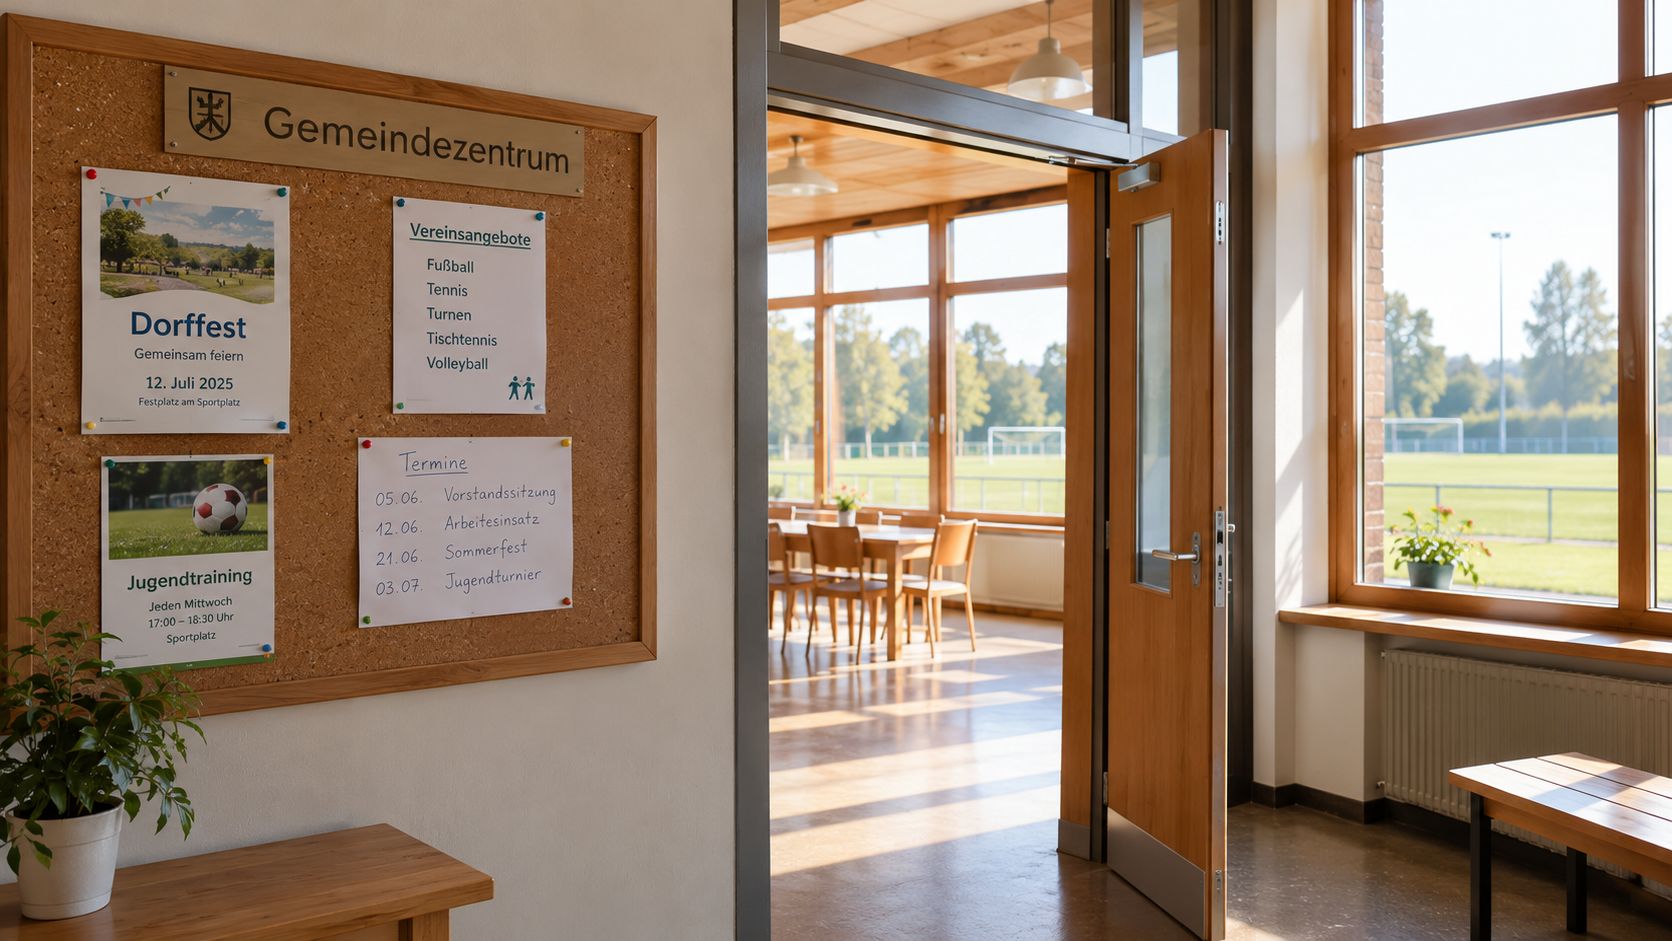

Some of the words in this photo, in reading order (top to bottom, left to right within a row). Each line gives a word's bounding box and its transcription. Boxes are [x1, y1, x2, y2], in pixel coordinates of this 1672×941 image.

[263, 105, 570, 174] Gemeindezentrum
[409, 222, 531, 247] Vereinsangebote
[427, 257, 475, 274] Fußball
[427, 282, 468, 297] Tennis
[427, 307, 473, 321] Turnen
[131, 311, 247, 339] Dorffest
[427, 331, 498, 347] Tischtennis
[134, 347, 207, 361] Gemeinsam
[210, 349, 244, 362] feiern
[427, 356, 488, 372] Volleyball
[146, 376, 167, 390] 12.
[171, 376, 195, 390] Juli
[199, 377, 234, 391] 2025
[138, 397, 180, 408] Festplatz
[181, 399, 195, 407] am
[197, 398, 241, 409] Sportplatz
[399, 451, 468, 472] Termine
[375, 490, 422, 506] 05.06.
[444, 484, 557, 505] Vorstandssitzung
[375, 520, 422, 536] 12.06.
[444, 511, 541, 531] Arbeitesinsatz
[376, 549, 422, 566] 21.06.
[445, 538, 527, 560] Sommerfest
[127, 569, 252, 593] Jugendtraining
[376, 579, 423, 596] 03.07.
[445, 569, 541, 594] Jugendturnier
[148, 601, 182, 613] Jeden
[184, 596, 233, 610] Mittwoch
[148, 616, 176, 629] 17:00
[188, 613, 214, 626] 18:30
[216, 612, 234, 623] Uhr
[166, 631, 216, 645] Sportplatz
